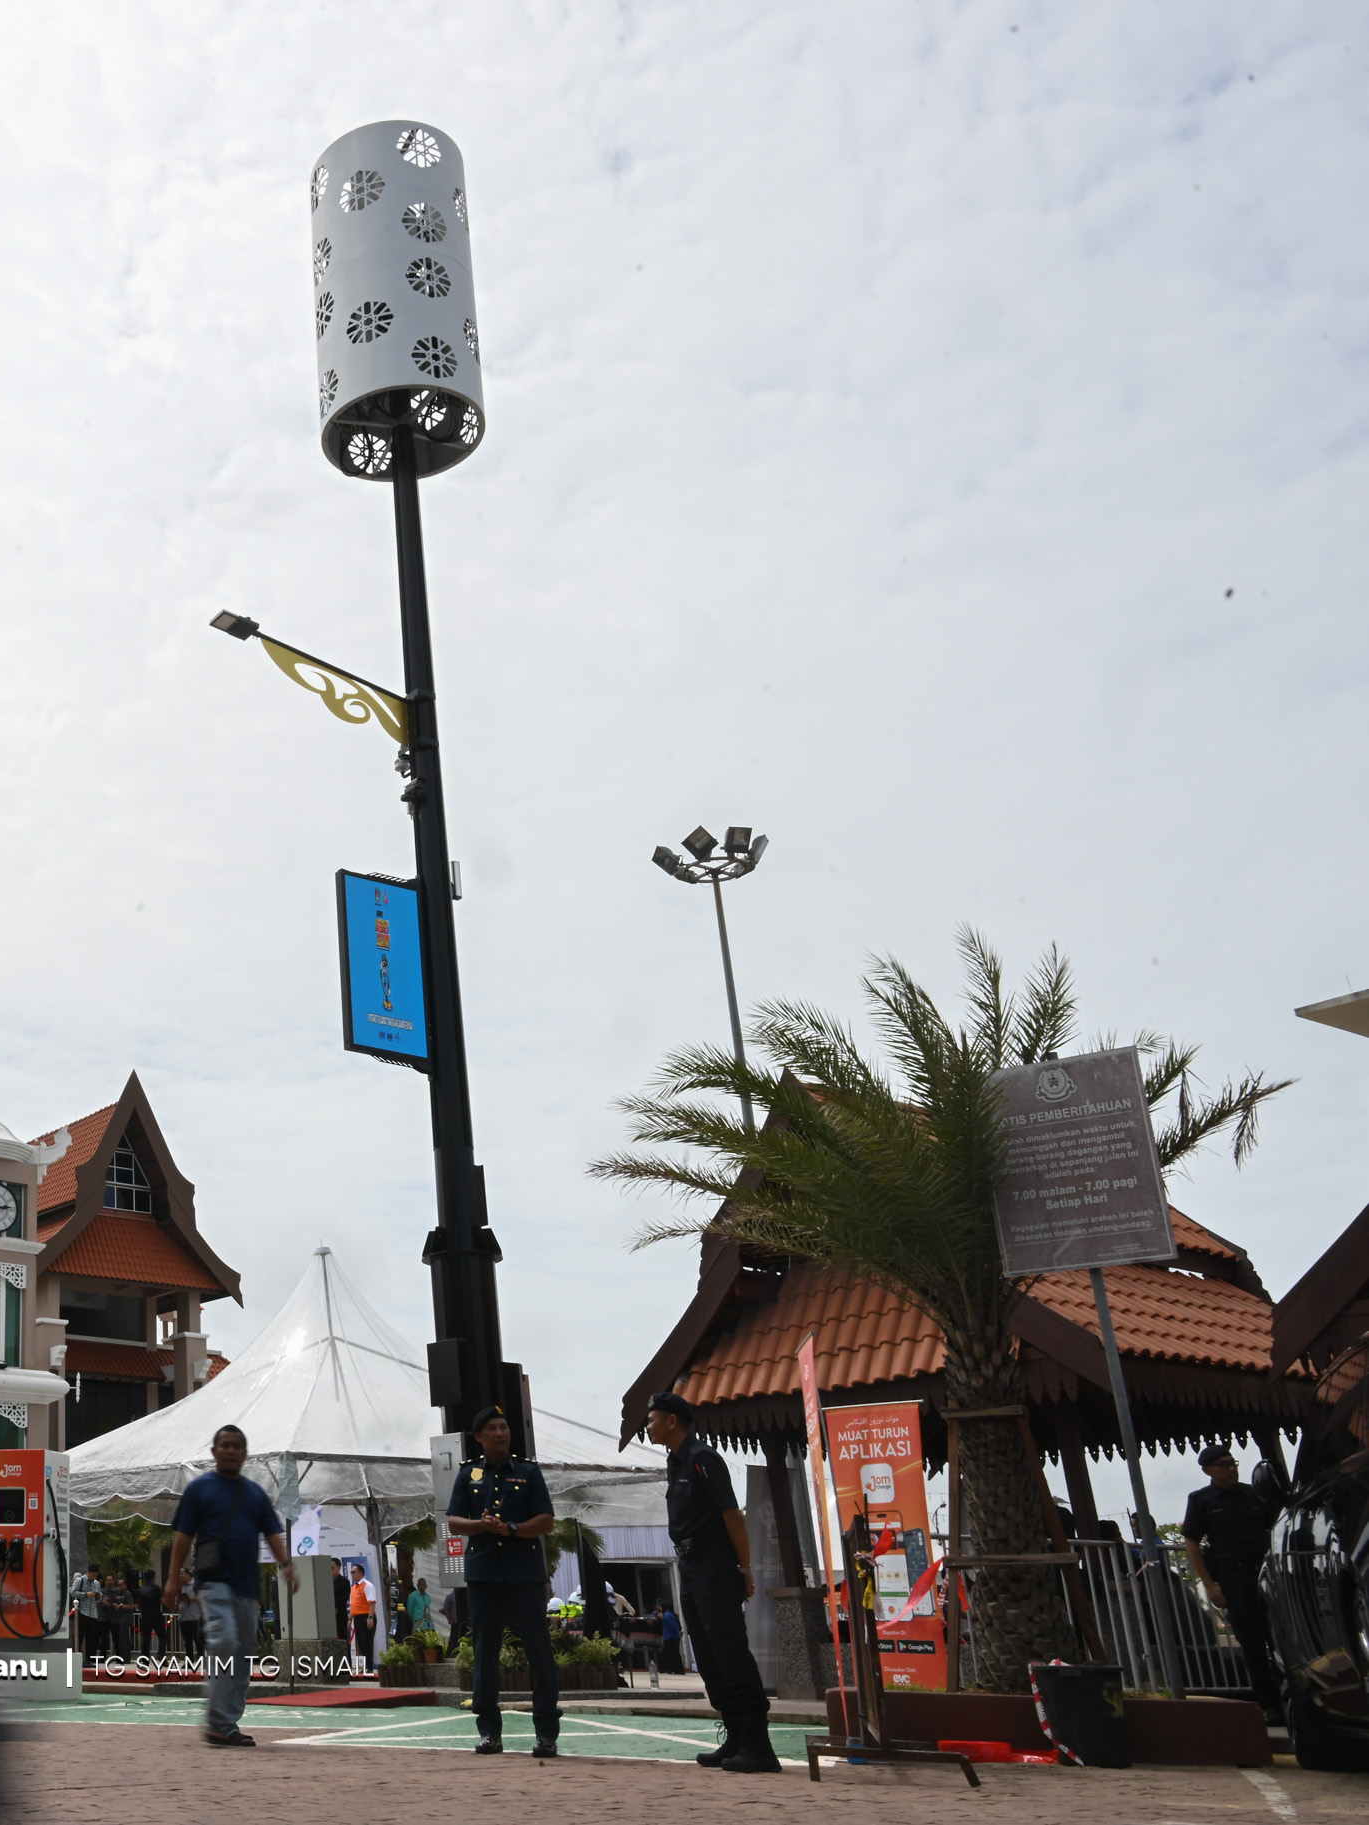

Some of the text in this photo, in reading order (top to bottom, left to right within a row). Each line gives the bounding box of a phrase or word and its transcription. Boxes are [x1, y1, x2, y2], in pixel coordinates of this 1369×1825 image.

[997, 1098, 1132, 1130] OTIS PEMBERITAHUAN
[1025, 1129, 1081, 1143] dimaklumkan
[1082, 1124, 1108, 1134] waktu
[1109, 1120, 1135, 1130] untuk
[1008, 1131, 1126, 1156] memunggah dan mengambil
[1005, 1141, 1132, 1165] barang-barang dagangan yang
[1049, 1160, 1058, 1169] di
[1059, 1155, 1103, 1168] sepanjang
[1104, 1152, 1126, 1163] jalan
[1127, 1150, 1139, 1158] ini
[1044, 1166, 1098, 1180] adalah pada:
[1012, 1189, 1037, 1201] 7.00
[1038, 1186, 1076, 1198] malam
[1084, 1179, 1110, 1192] 7.00
[1112, 1175, 1138, 1190] pagi
[1045, 1192, 1108, 1210] Setiap Hari
[1090, 1214, 1118, 1223] arahan
[1118, 1211, 1130, 1219] ini
[1130, 1209, 1154, 1218] boleh
[1014, 1232, 1053, 1242] dikenakan
[837, 1426, 909, 1442] MUAT TURUN
[839, 1440, 912, 1461] APLIKASI
[869, 1475, 891, 1492] Jom
[907, 1643, 934, 1652] Google Play
